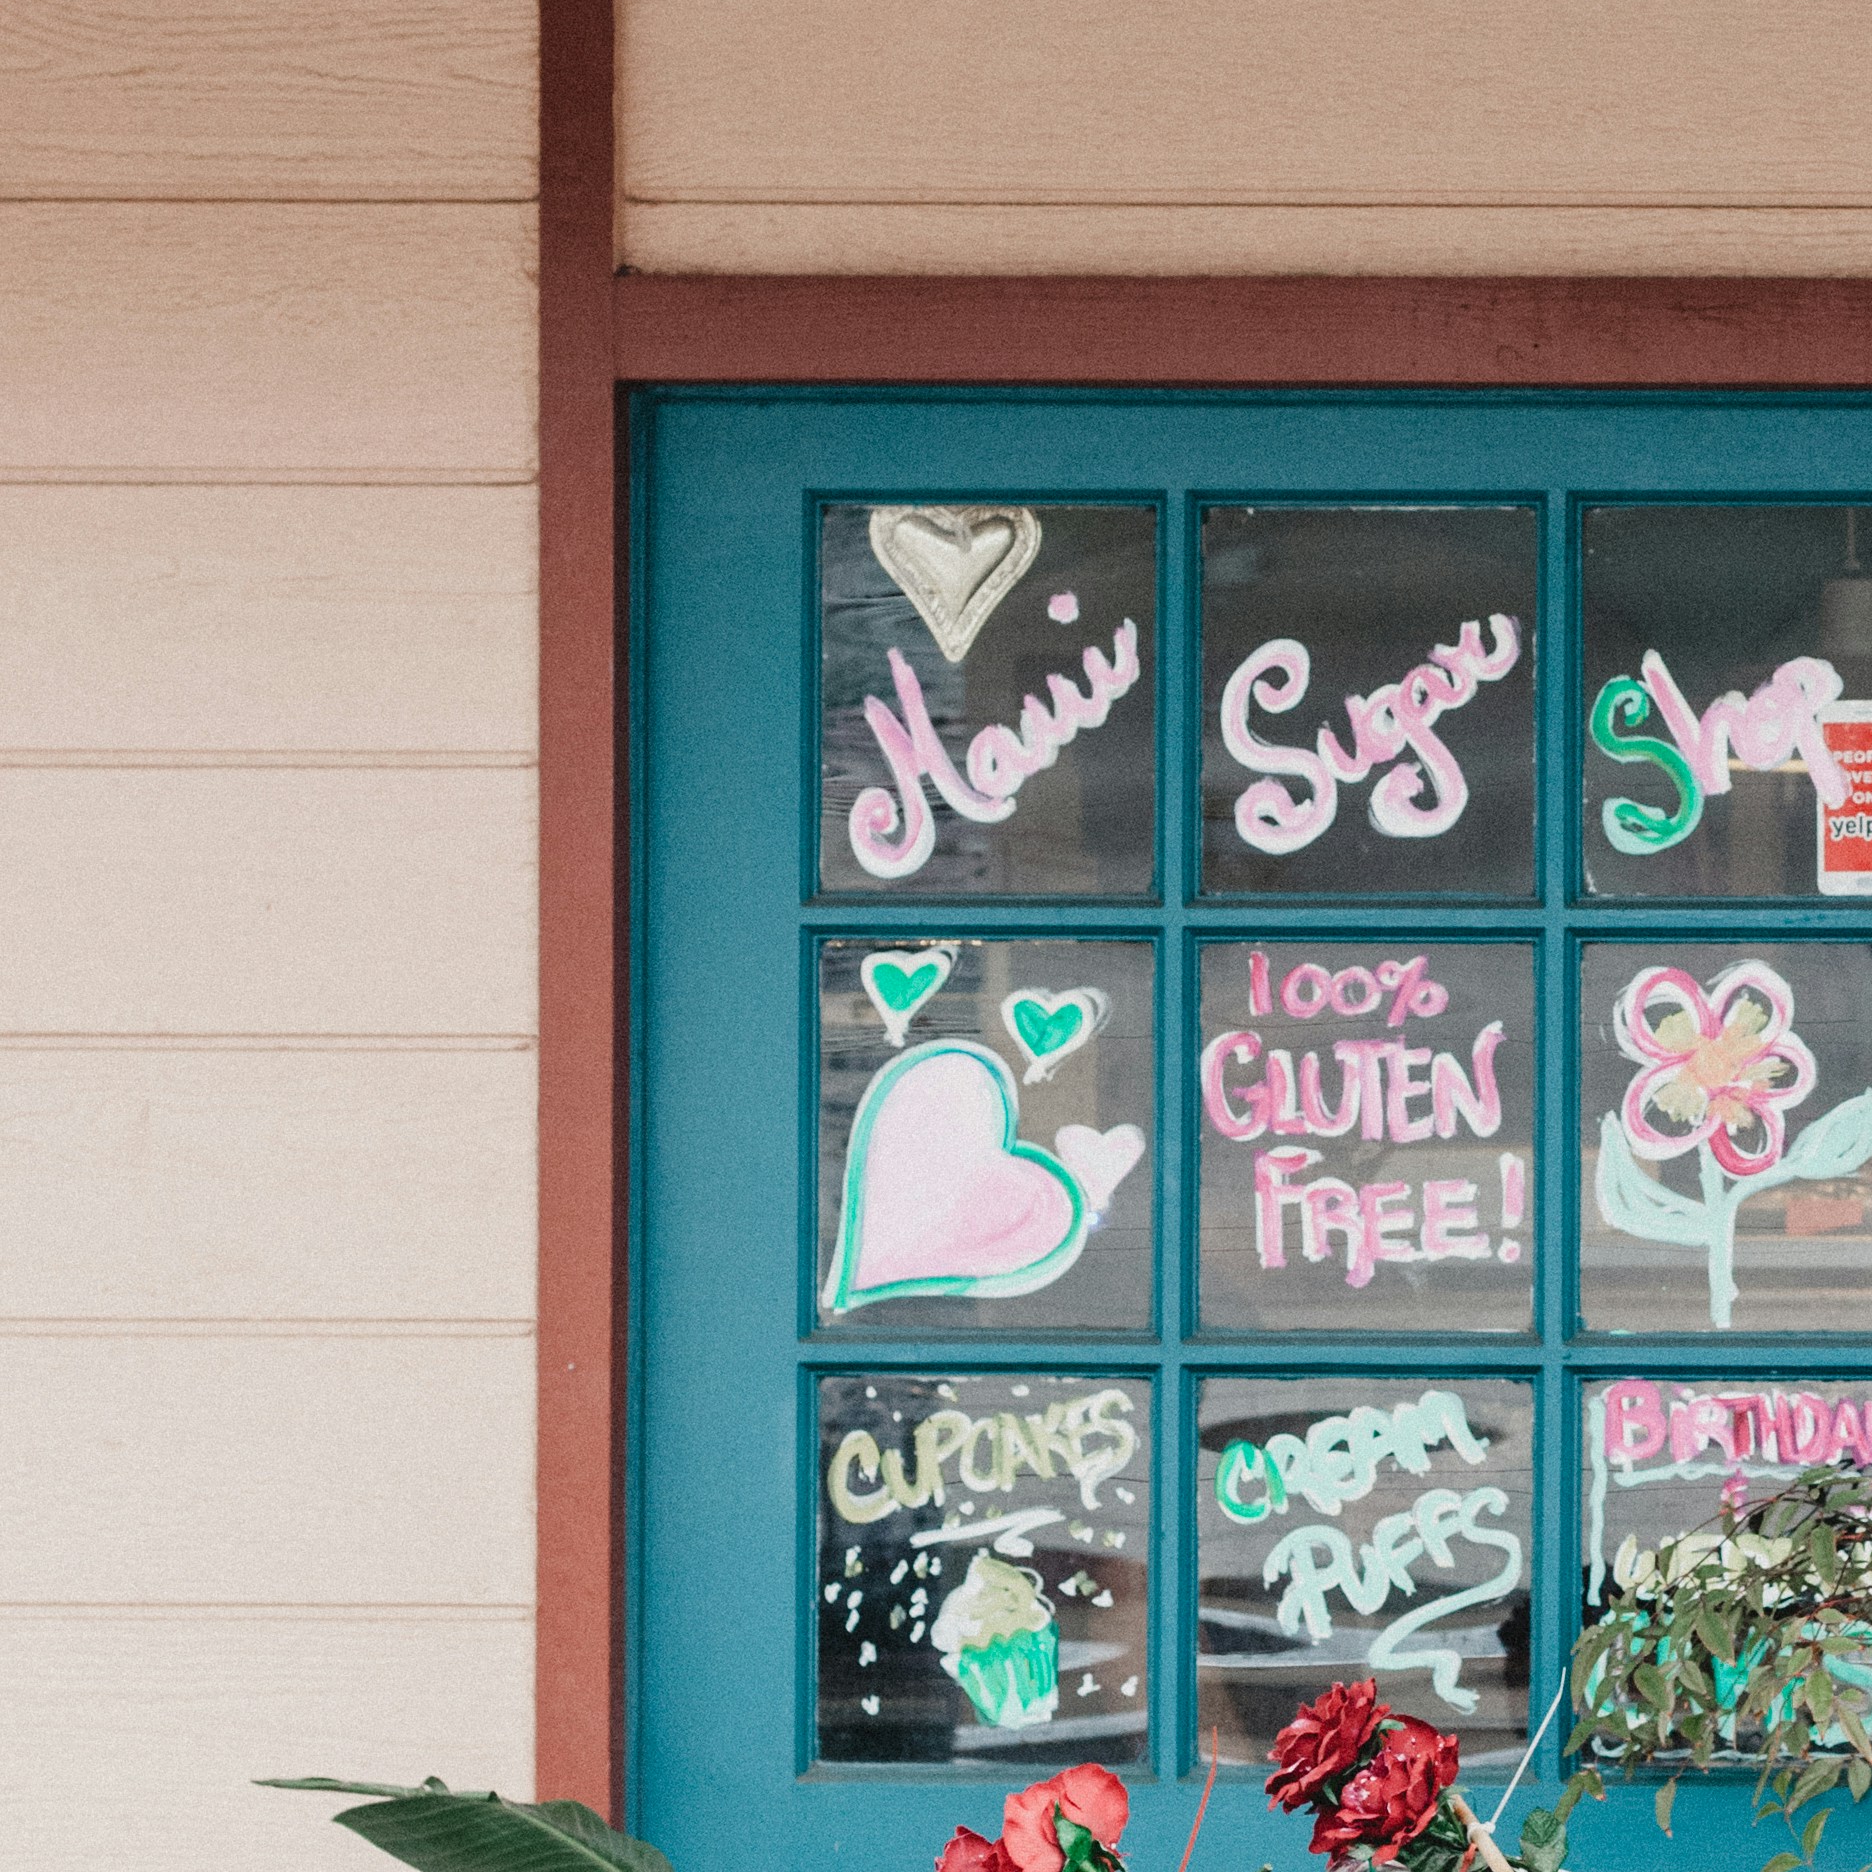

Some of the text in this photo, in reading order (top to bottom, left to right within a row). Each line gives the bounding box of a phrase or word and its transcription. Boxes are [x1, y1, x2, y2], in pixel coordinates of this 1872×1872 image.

[849, 591, 1854, 879] Maui Sugar Shop
[1248, 952, 1449, 1027] 100%
[1201, 1021, 1507, 1143] GLUTEN
[1254, 1145, 1524, 1288] FREE!
[827, 1388, 1142, 1524] CUPCAKES
[1214, 1389, 1490, 1525] CREAM
[1263, 1487, 1522, 1668] PUFFS
